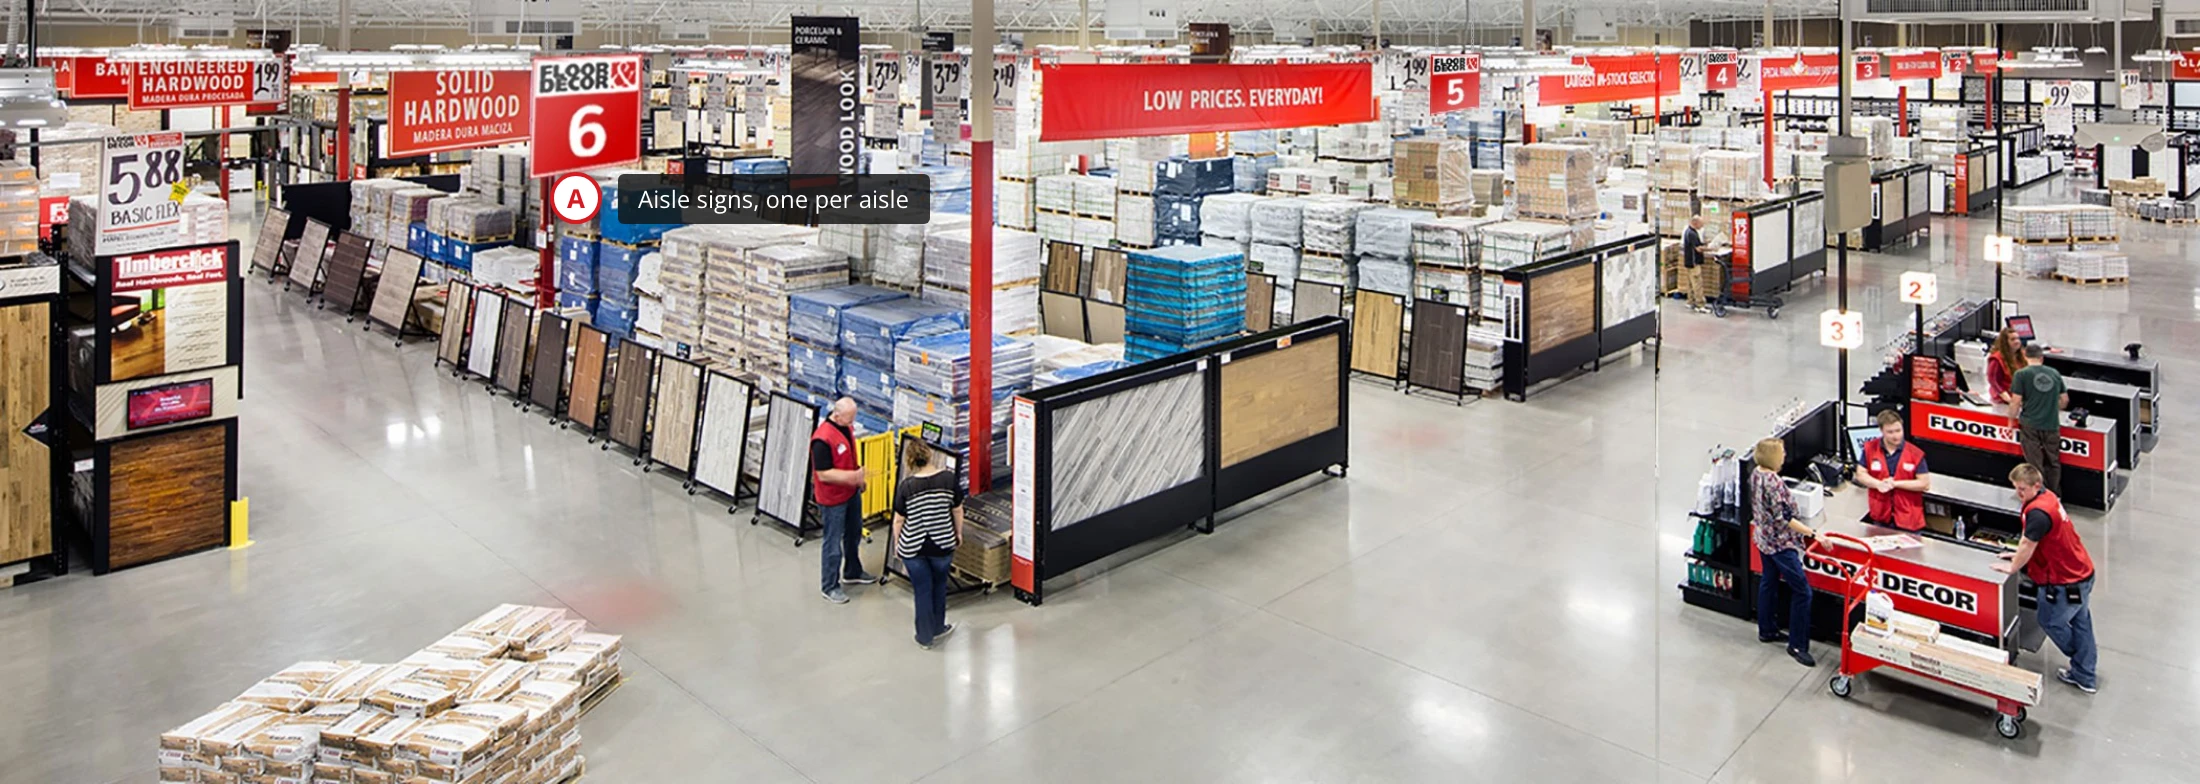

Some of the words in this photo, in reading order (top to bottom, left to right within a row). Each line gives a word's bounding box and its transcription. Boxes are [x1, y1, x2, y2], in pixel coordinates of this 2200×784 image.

[795, 26, 835, 35] PORCELAIN
[794, 36, 828, 44] CERAMIC
[138, 61, 248, 76] ENGINEERED
[540, 62, 609, 80] FLOOR
[1434, 57, 1466, 67] FLOOR
[1434, 64, 1466, 72] DECOR
[1864, 64, 1873, 77] 3
[1954, 60, 1962, 71] 2
[142, 75, 244, 92] HARDWOOD
[436, 70, 494, 96] SOLID
[540, 76, 609, 93] DECOR
[1716, 66, 1728, 86] 4
[142, 94, 176, 103] MADERA
[179, 94, 200, 102] DURA
[201, 92, 245, 101] PROCESADA
[839, 69, 855, 121] LOOK
[1143, 90, 1183, 111] LOW
[1190, 89, 1246, 110] PRICES.
[1249, 87, 1323, 107] EVERYDAY!
[1447, 78, 1465, 105] 5
[404, 95, 520, 127] HARDWOOD
[413, 129, 452, 143] MADERA
[454, 126, 479, 140] DURA
[481, 122, 513, 136] MACIZA
[568, 104, 607, 158] 6
[111, 206, 153, 225] BASIC
[155, 201, 180, 220] FLEX
[1993, 243, 2001, 257] 1
[1909, 281, 1922, 299] 2
[1831, 321, 1844, 341] 3
[1930, 415, 1997, 438] FLOOR
[1882, 572, 1976, 612] DECOR
